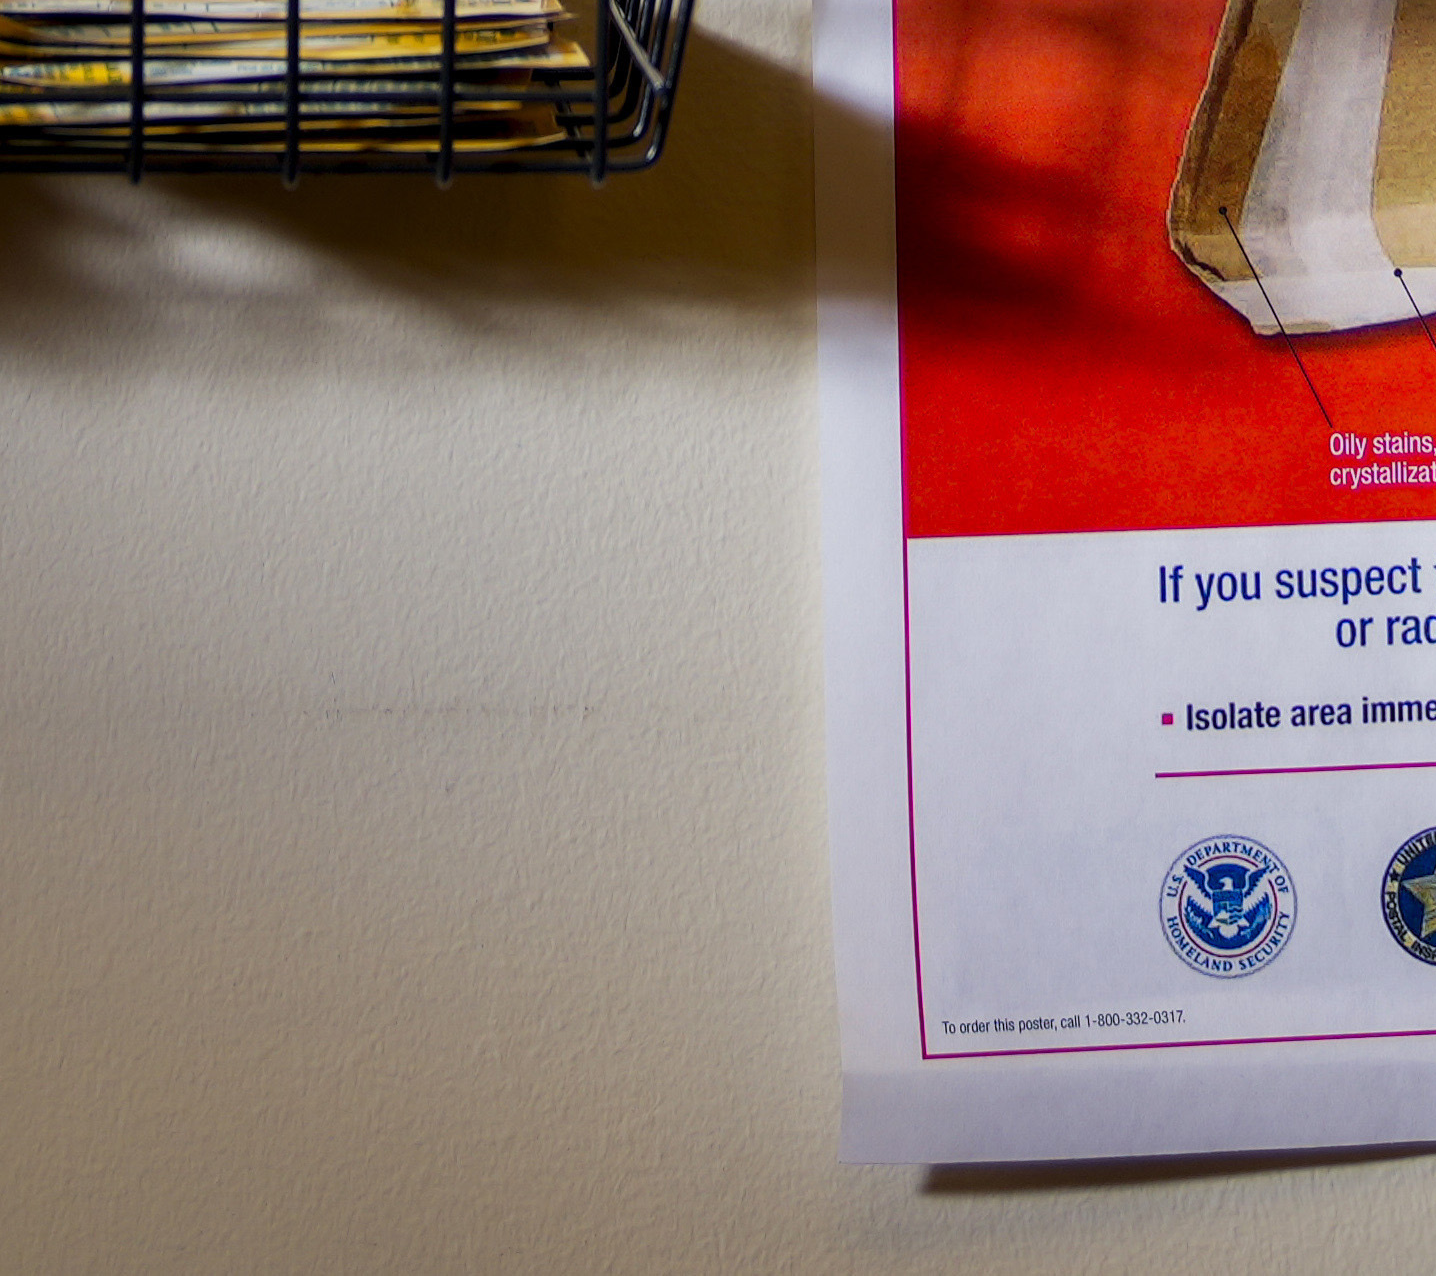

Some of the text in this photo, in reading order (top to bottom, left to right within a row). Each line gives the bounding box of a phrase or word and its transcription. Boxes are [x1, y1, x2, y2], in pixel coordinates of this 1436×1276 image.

[1159, 564, 1184, 604] If
[1194, 571, 1261, 612] you
[1275, 557, 1422, 606] suspect
